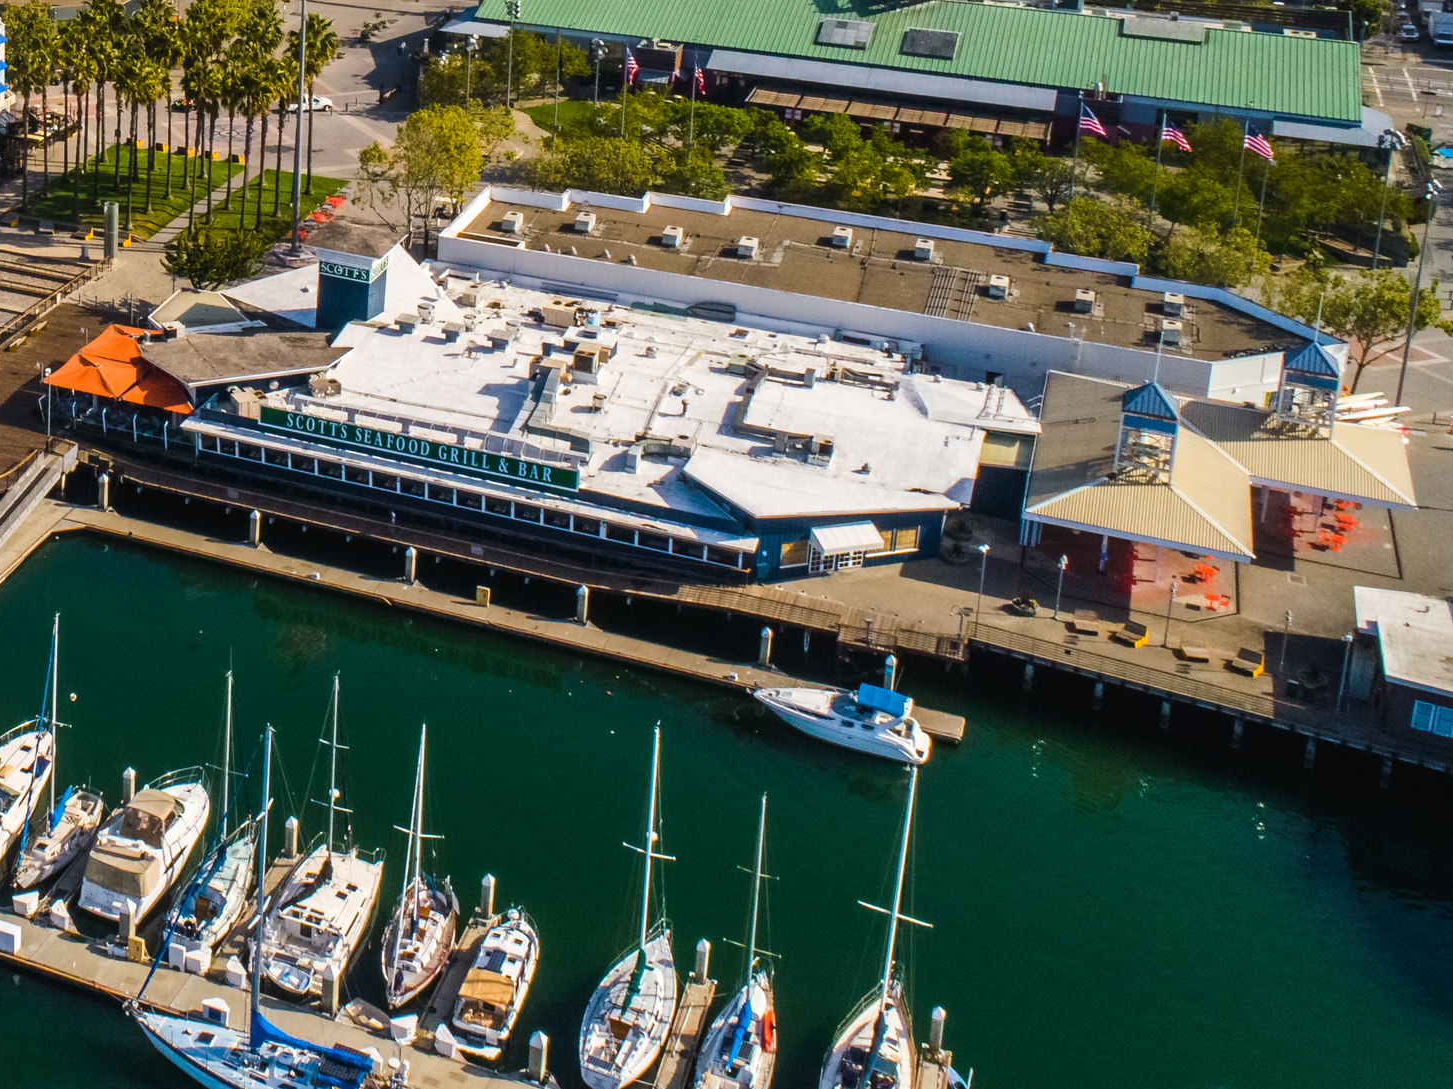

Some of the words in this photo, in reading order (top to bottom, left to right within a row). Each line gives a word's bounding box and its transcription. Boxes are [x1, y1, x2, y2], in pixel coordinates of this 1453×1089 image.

[320, 262, 368, 281] SCOTT'S
[286, 413, 348, 439] SCOTT'S
[354, 427, 431, 457] SEAFOOD
[438, 445, 490, 470] GRILL
[498, 457, 509, 474] &
[518, 461, 552, 483] BAR
